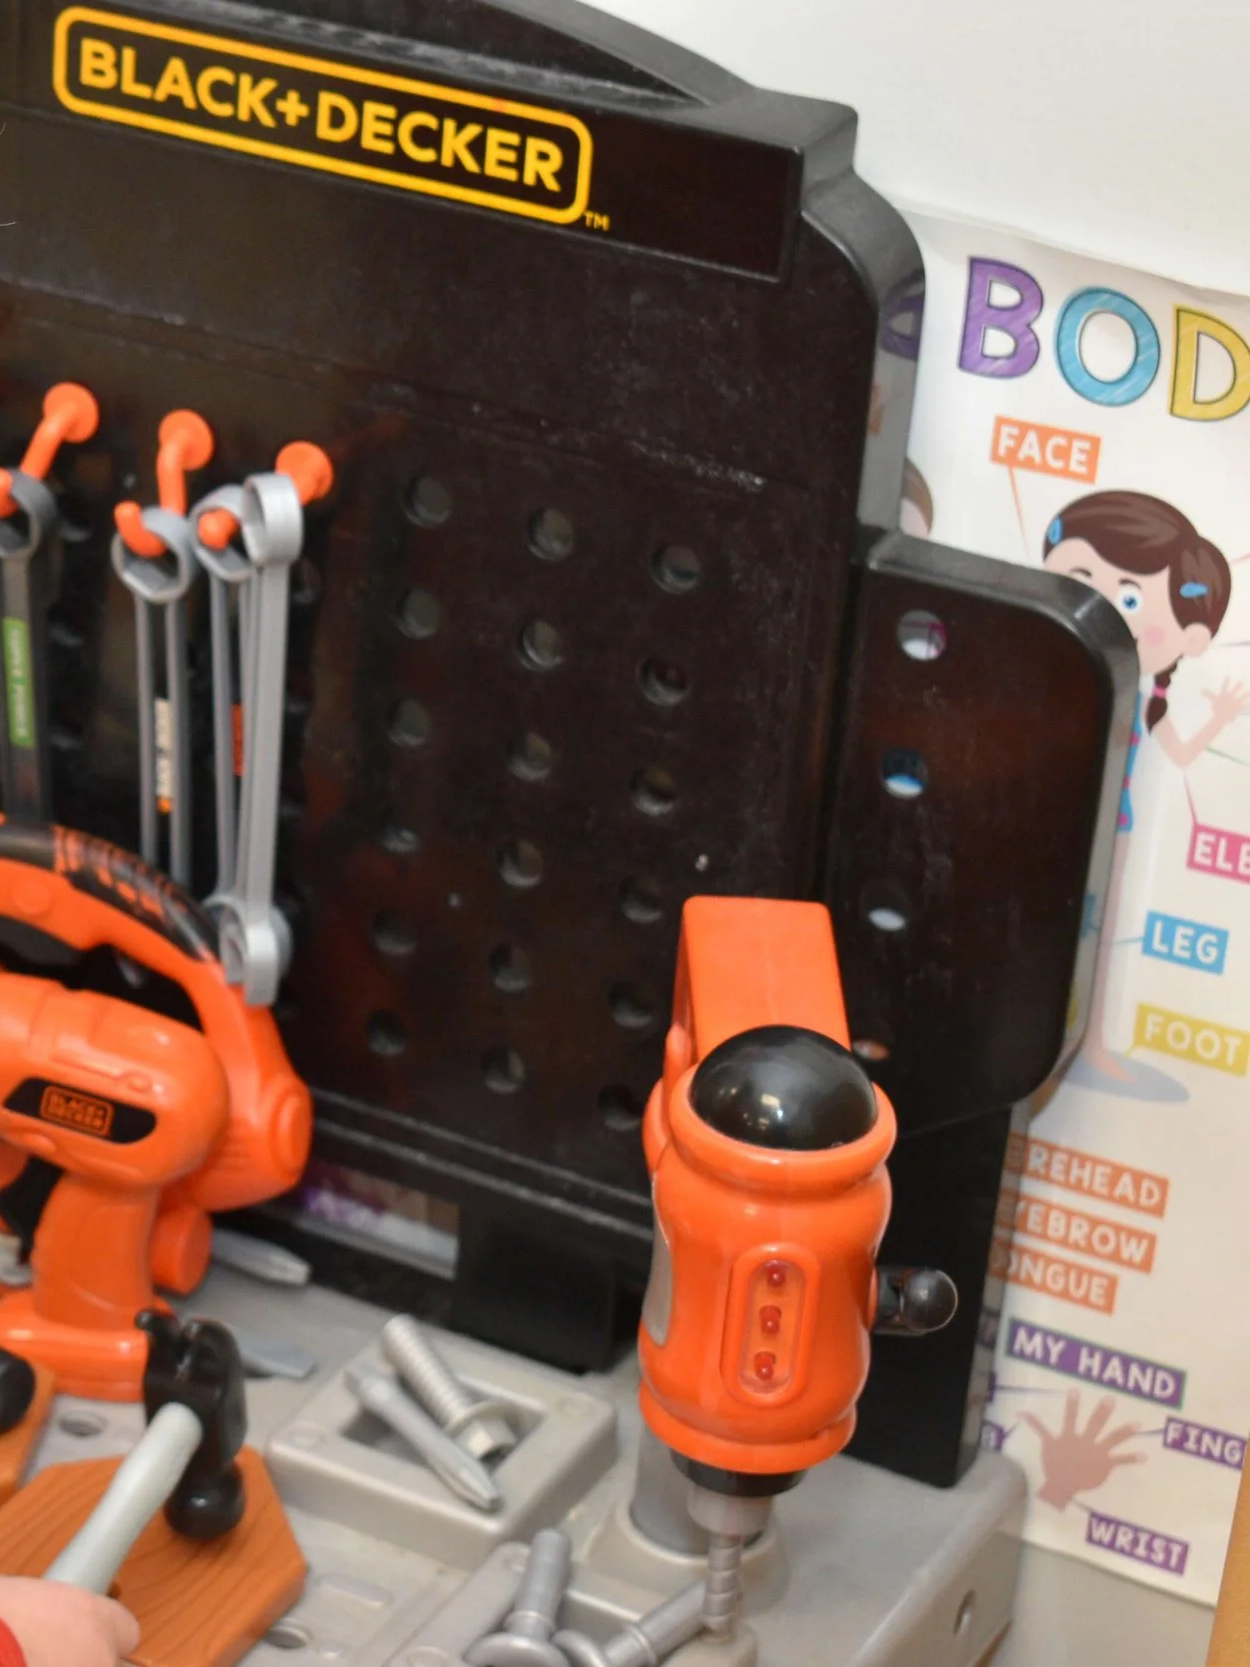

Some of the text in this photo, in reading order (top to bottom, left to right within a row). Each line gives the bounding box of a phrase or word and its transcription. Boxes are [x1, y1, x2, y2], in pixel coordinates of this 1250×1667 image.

[80, 37, 564, 192] BLACK+DECKER
[584, 211, 610, 231] TM
[958, 255, 1250, 422] BOD
[997, 424, 1092, 474] FACE
[1151, 919, 1220, 965] LEG
[1144, 1014, 1243, 1067] FOOT
[1028, 1143, 1161, 1207] REHEAD
[1012, 1326, 1176, 1398] MY HAND
[1165, 1422, 1243, 1466] FING
[1088, 1516, 1185, 1570] WRIST
